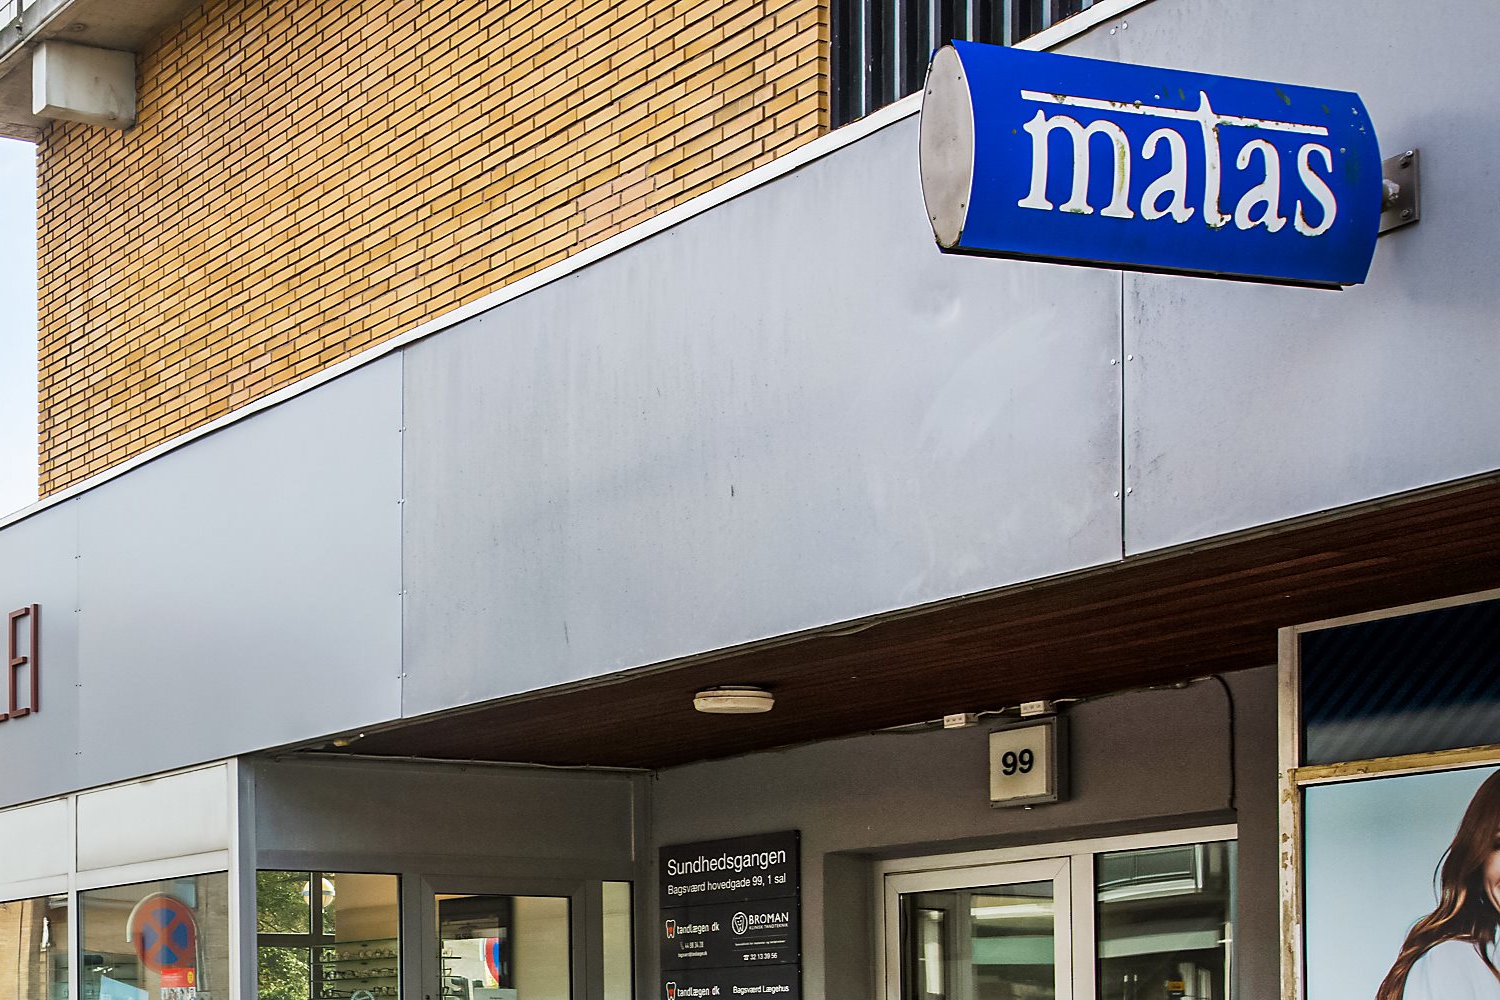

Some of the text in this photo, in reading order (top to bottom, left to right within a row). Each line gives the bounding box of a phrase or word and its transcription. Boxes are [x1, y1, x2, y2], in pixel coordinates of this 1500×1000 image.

[1017, 90, 1338, 237] matas
[1001, 748, 1035, 776] 99
[667, 850, 786, 876] Sundhedsgangen
[667, 872, 787, 896] Bagsværd hovedgade 99, 1 sal
[748, 912, 789, 925] BROMAN
[732, 984, 790, 996] Bagsværd Lægehus
